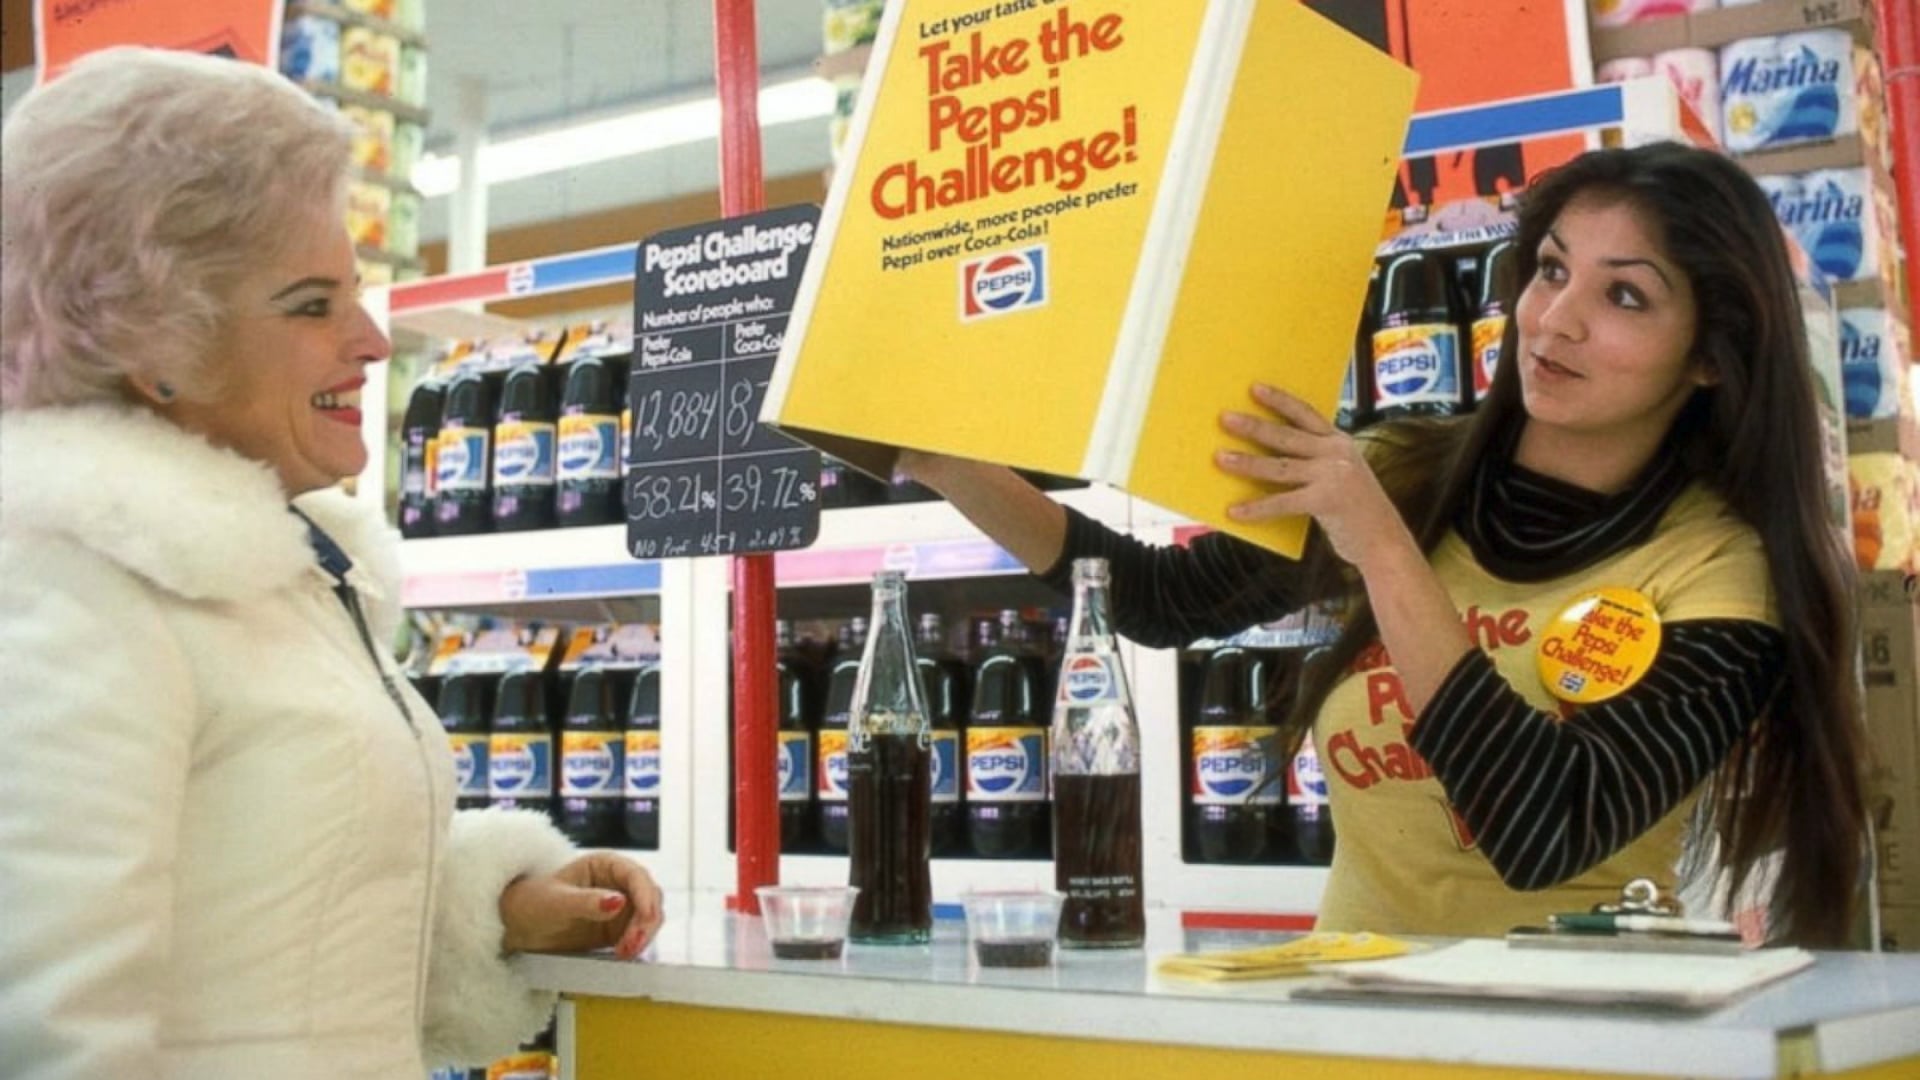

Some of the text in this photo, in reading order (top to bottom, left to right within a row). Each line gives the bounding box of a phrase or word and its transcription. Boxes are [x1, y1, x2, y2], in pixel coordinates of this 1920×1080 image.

[920, 0, 1038, 39] Let your taste
[919, 7, 1124, 96] Take the
[1722, 57, 1840, 97] Marina
[928, 68, 1061, 152] Pepsi
[870, 105, 1139, 220] Challenge!
[882, 182, 1139, 252] Nationwide, more people prefer
[645, 221, 814, 273] Pepsi Challenge
[882, 219, 1050, 271] Pepsi over Coca-Cola!
[663, 249, 789, 297] Scoreboard
[976, 270, 1033, 294] PEPSI
[642, 293, 775, 330] Number of people who:
[734, 321, 766, 339] Prefer
[641, 333, 672, 351] Prefer
[1377, 355, 1438, 375] PEPSI
[634, 388, 719, 450] 12,884
[1461, 604, 1532, 651] he
[1572, 624, 1622, 656] Pepsi
[1614, 616, 1645, 641] the
[1541, 636, 1633, 686] Challenge!
[971, 754, 1025, 771] PEPSI
[1201, 756, 1263, 774] PEPSI
